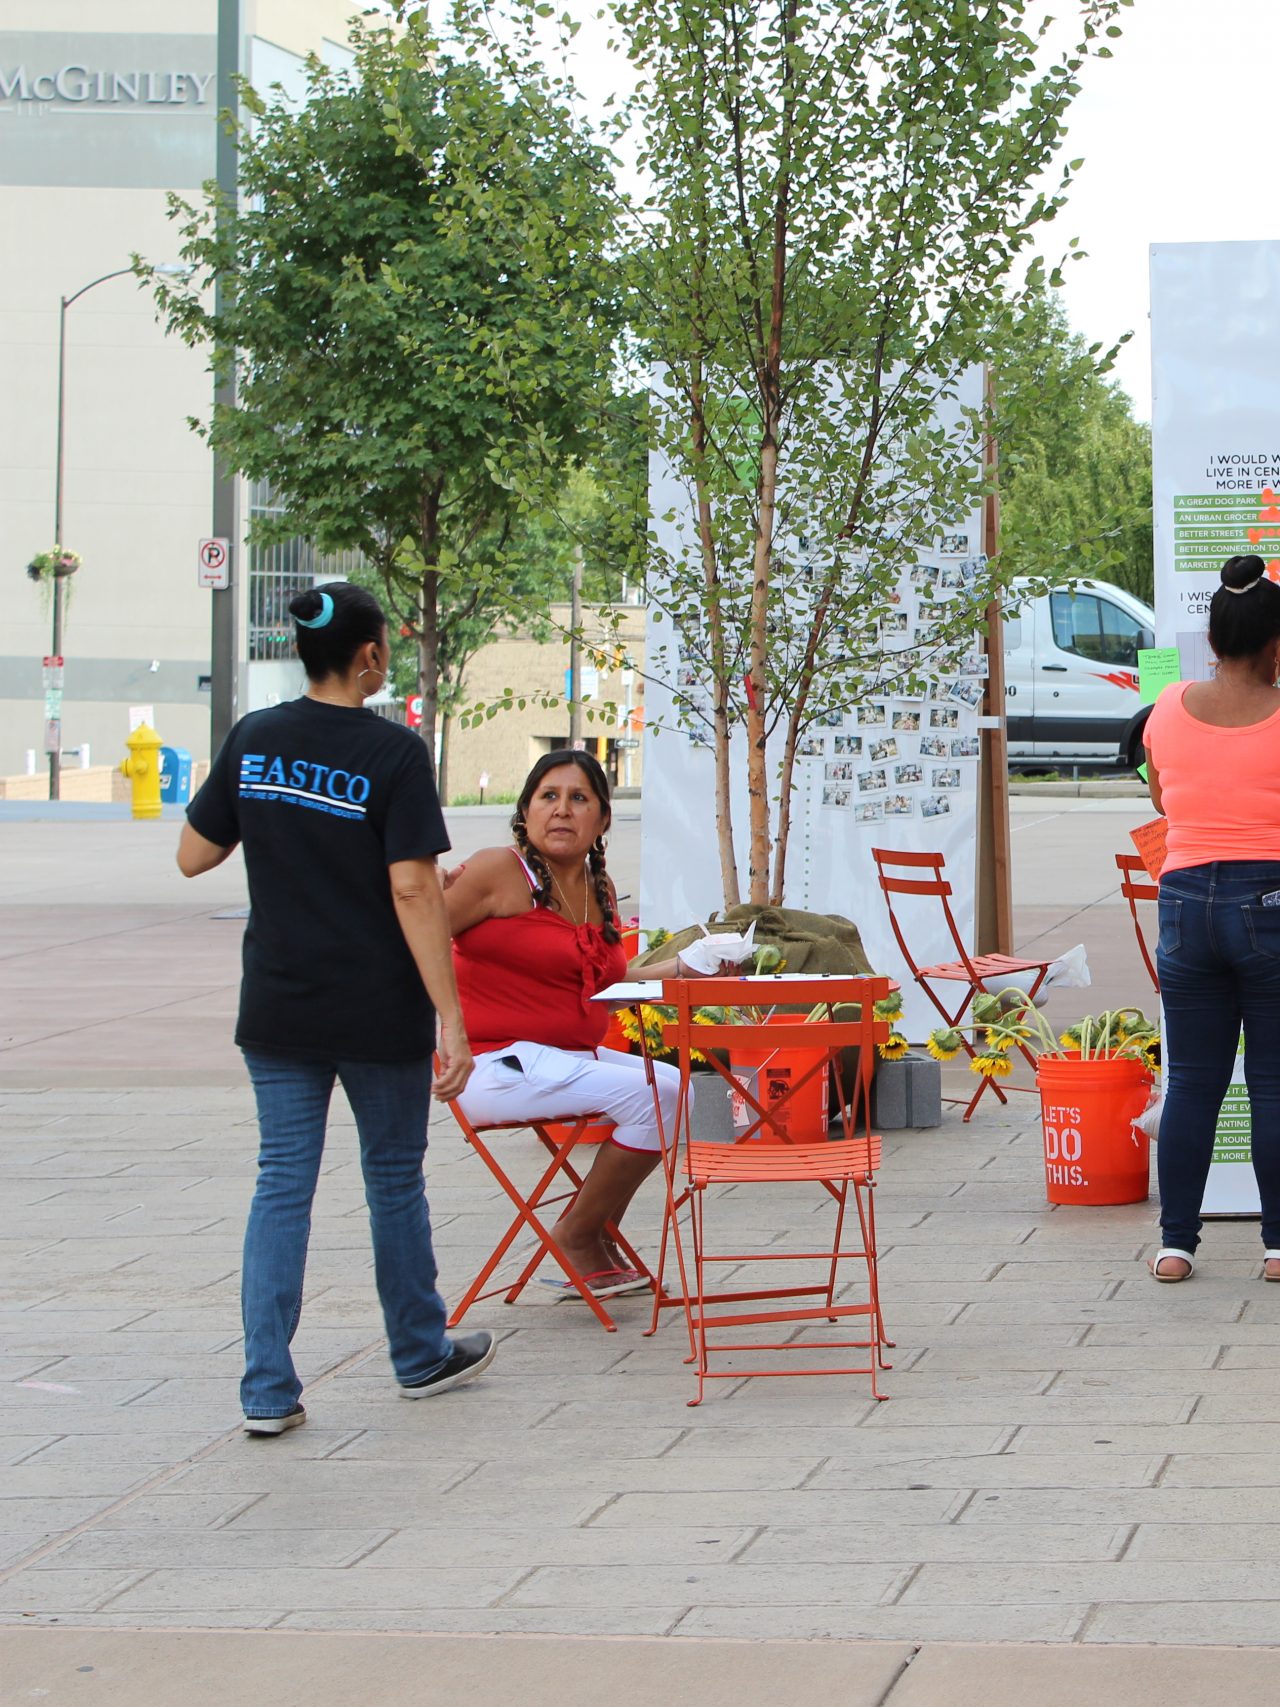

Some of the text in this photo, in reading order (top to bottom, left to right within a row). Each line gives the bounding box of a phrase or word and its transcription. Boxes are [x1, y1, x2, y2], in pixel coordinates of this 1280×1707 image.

[1210, 456, 1213, 465] I
[1217, 454, 1268, 465] WOULD
[1206, 467, 1233, 478] LIVE
[1237, 467, 1250, 477] IN
[1216, 480, 1254, 490] MORE
[1257, 479, 1269, 489] IF
[1178, 496, 1257, 506] A GREAT DOG PARK
[1178, 513, 1257, 522] AN URBAN GROCER
[1179, 529, 1244, 538] BETTER STREETS
[1179, 545, 1210, 553] BETTER
[1210, 544, 1267, 552] CONNECTION
[1267, 543, 1280, 551] TO
[1179, 560, 1218, 569] MARKETS
[1187, 591, 1214, 601] WIS
[239, 753, 371, 804] EASTCO
[1220, 1103, 1238, 1112] ORE
[1043, 1104, 1082, 1125] LET'S
[1044, 1126, 1082, 1162] DO
[1221, 1152, 1246, 1160] MORE
[1046, 1162, 1089, 1186] THIS.
